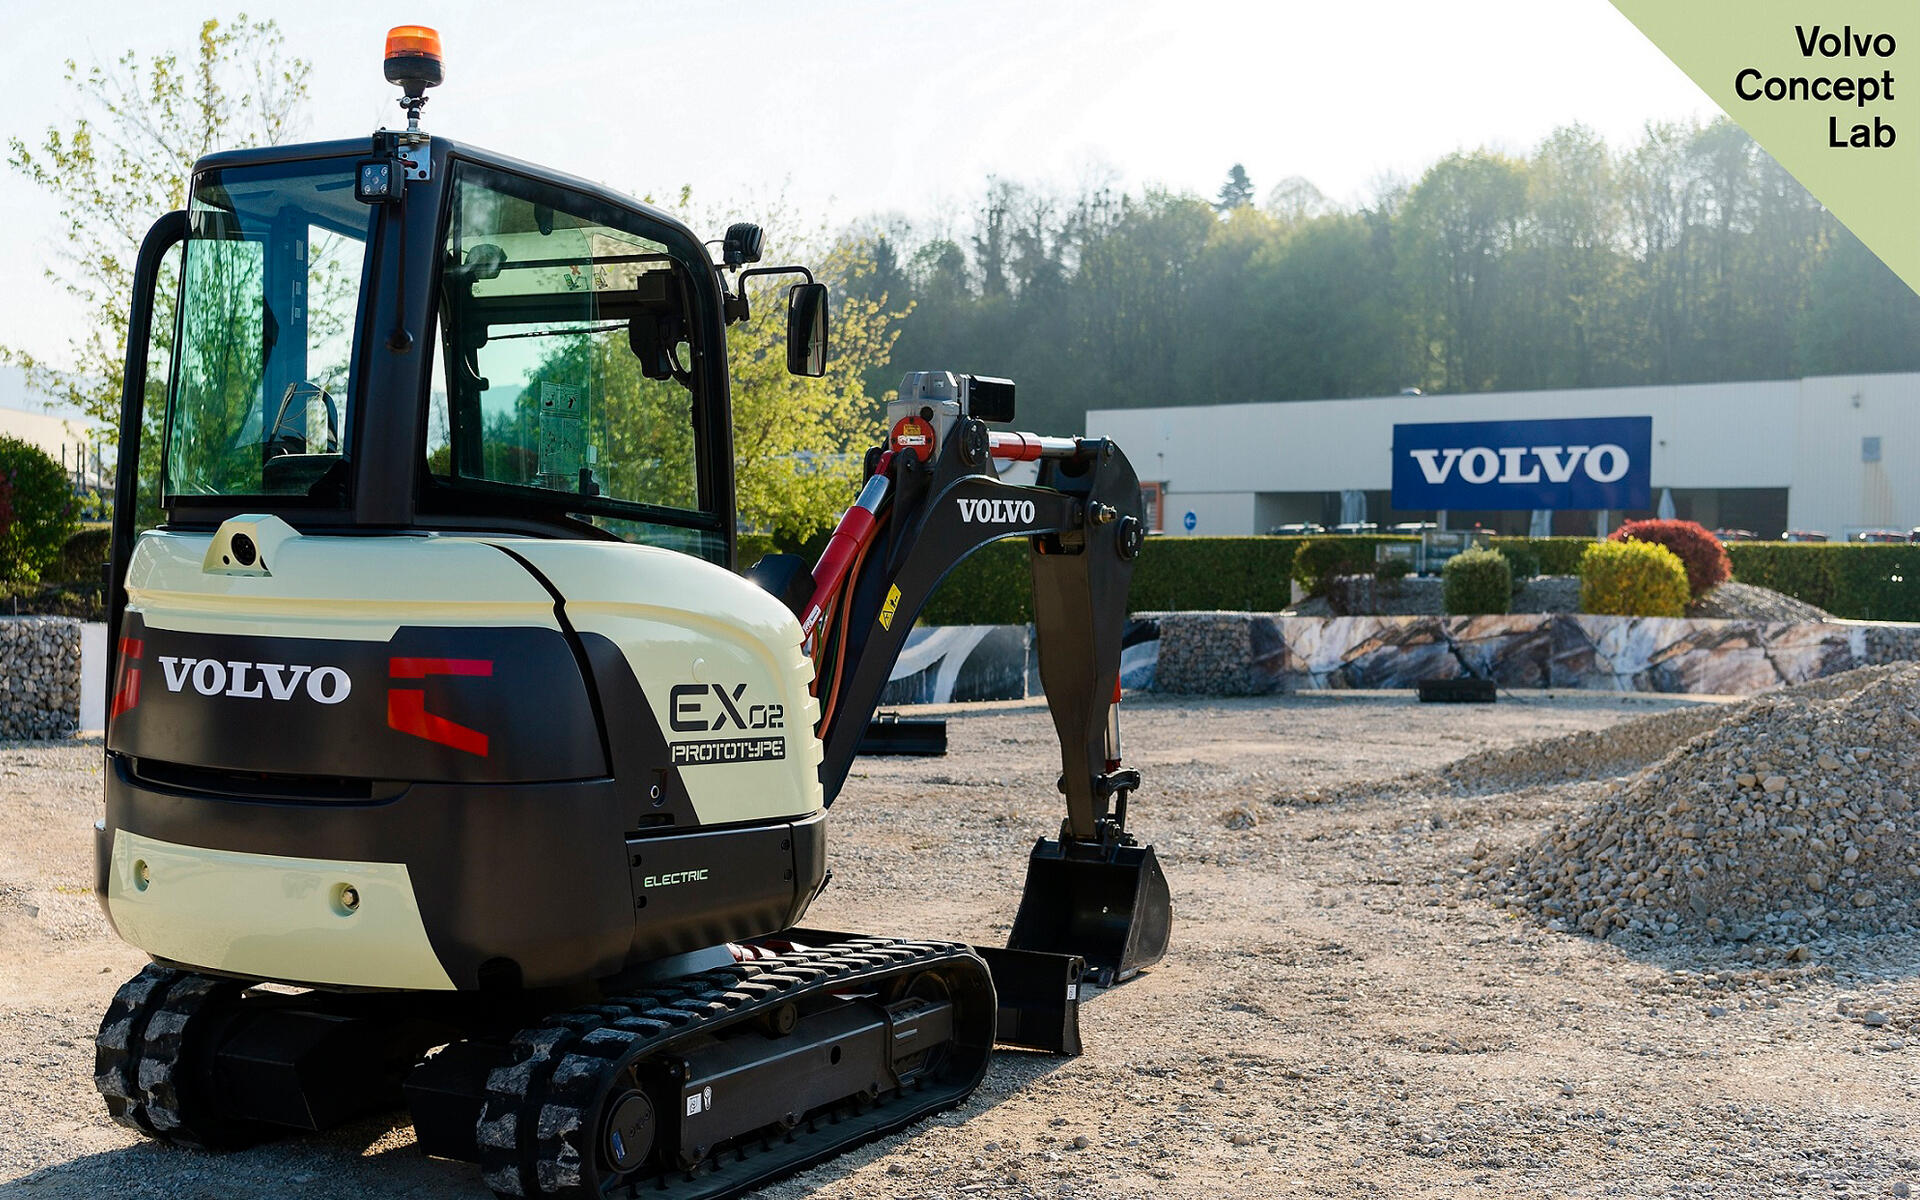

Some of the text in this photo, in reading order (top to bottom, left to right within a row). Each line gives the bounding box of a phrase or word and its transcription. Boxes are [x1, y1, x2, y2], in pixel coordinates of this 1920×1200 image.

[1410, 444, 1629, 484] VOLVO
[957, 498, 1036, 524] VOLVO
[159, 655, 352, 704] VOLVO
[671, 740, 784, 763] PROTOTYPE
[644, 869, 709, 888] ELECTRIC
